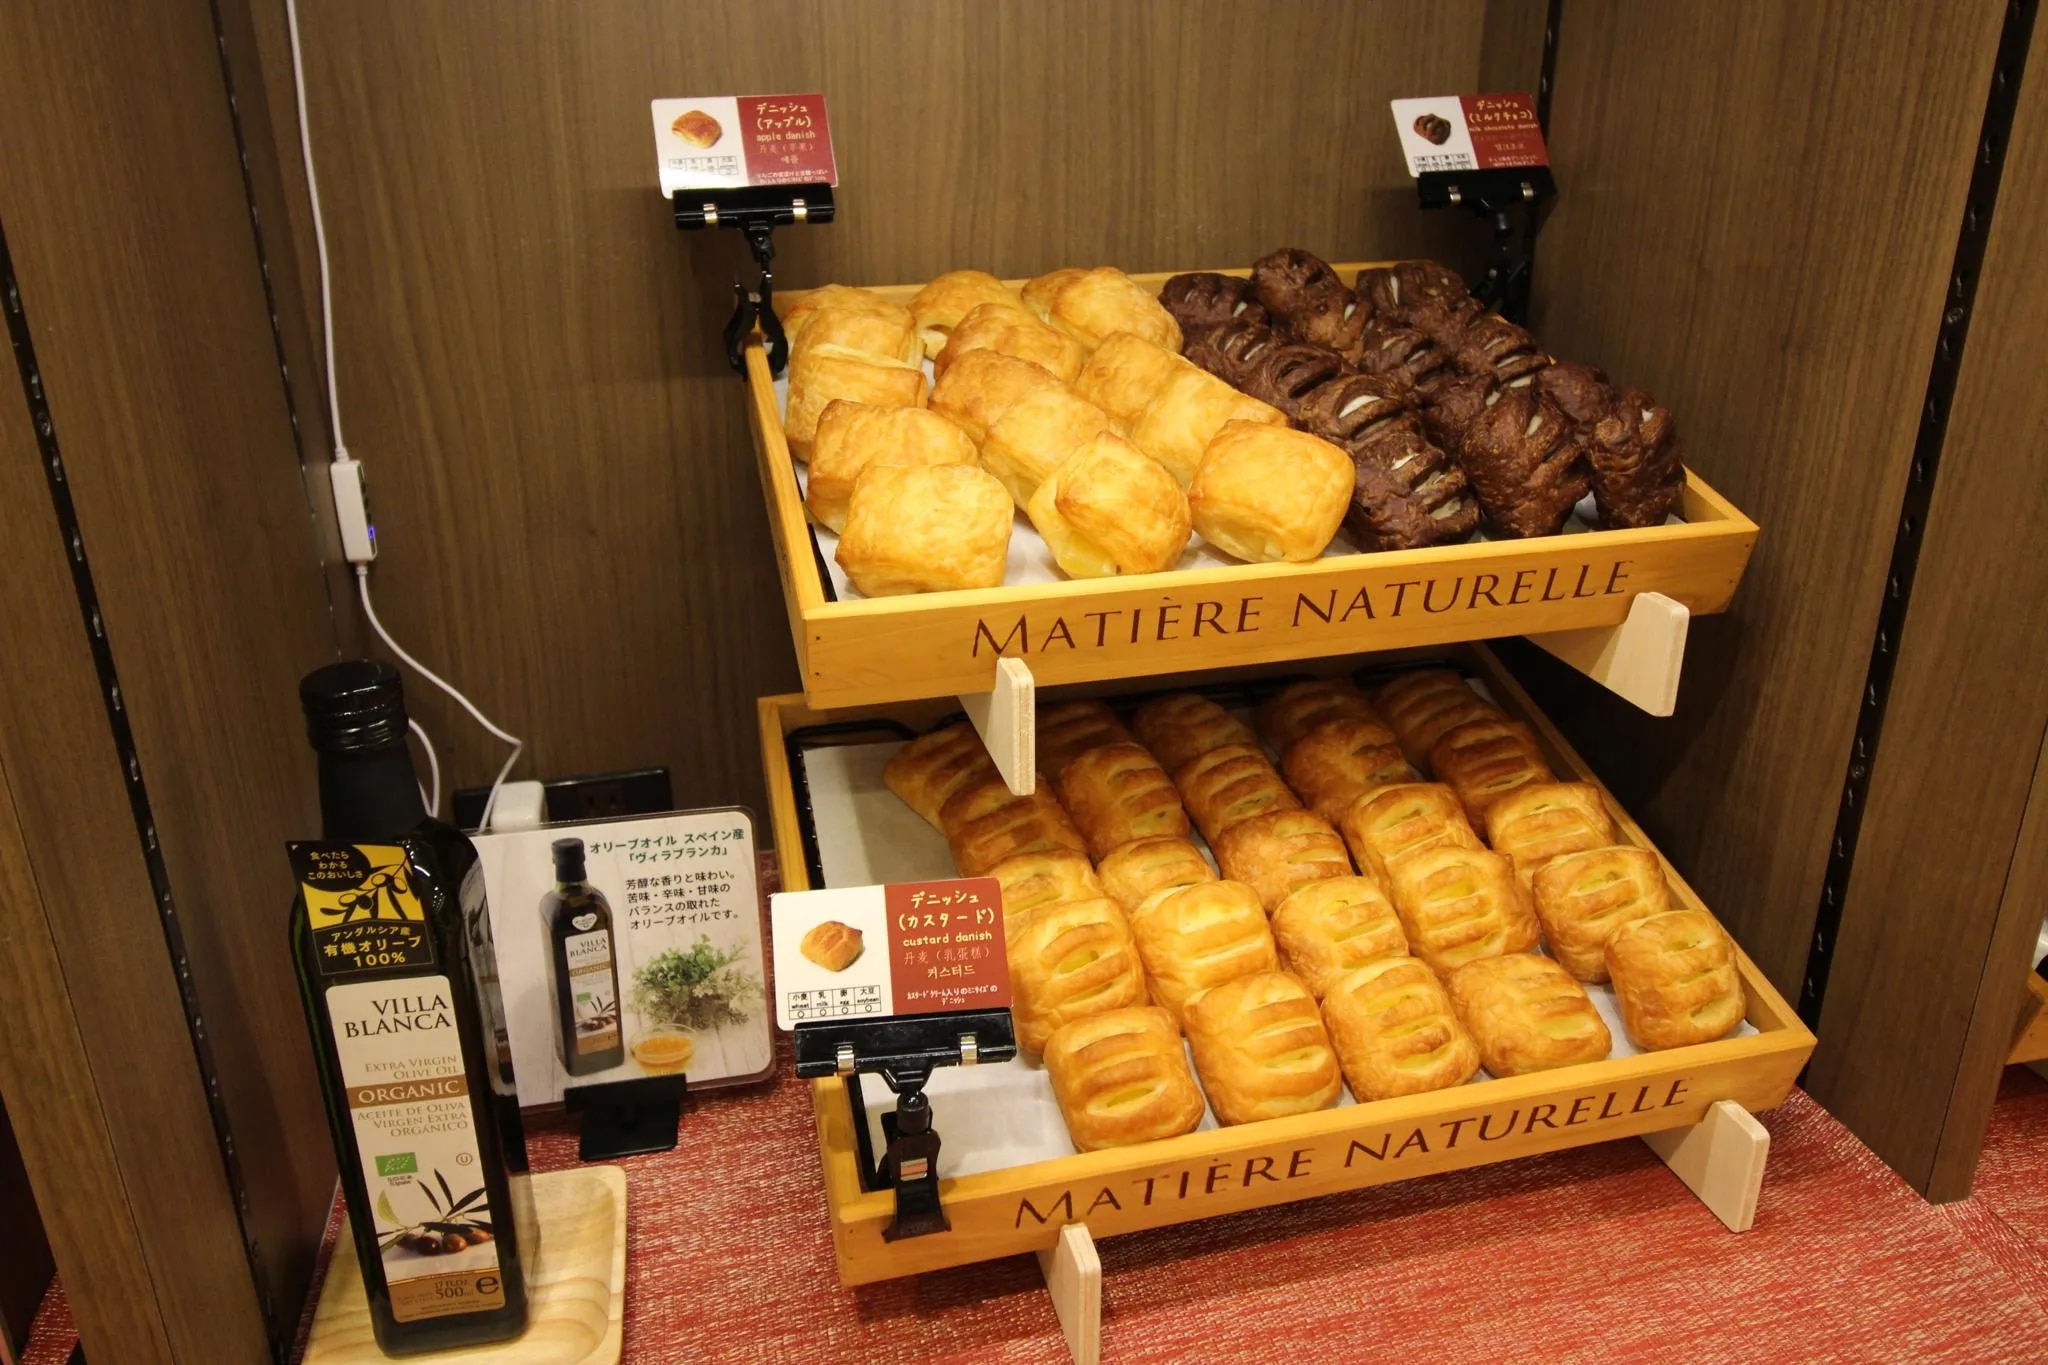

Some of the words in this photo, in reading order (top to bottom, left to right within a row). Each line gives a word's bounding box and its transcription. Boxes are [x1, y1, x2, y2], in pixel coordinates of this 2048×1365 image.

[756, 102, 808, 115] デニッシュ
[1476, 99, 1519, 110] デニッシュ
[756, 132, 781, 142] apple
[785, 130, 816, 140] danish
[972, 597, 1263, 658] MATIÈRE
[1291, 560, 1634, 627] NATURELLE
[590, 834, 677, 854] オリーブオイル
[684, 828, 744, 845] スペイン産
[309, 851, 350, 861] 食べたら
[629, 845, 728, 863] 「ヴィラブランカ」
[318, 862, 348, 870] わかる
[307, 871, 363, 880] このおいしさ
[625, 870, 735, 890] 芳醇な香りと味わい。
[627, 884, 730, 904] 苦味・辛味・甘味の
[911, 890, 979, 909] デニッシュ
[629, 898, 720, 917] バランスの取れた
[630, 910, 739, 930] オリーブオイルです。
[331, 926, 411, 942] アンダルシア産
[903, 932, 950, 947] custard
[955, 930, 992, 943] danish
[354, 951, 406, 967] 100%
[927, 965, 976, 978] 커스터드
[371, 994, 448, 1015] VILLA
[344, 1013, 452, 1038] BLANCA
[365, 1061, 405, 1073] EXTRA
[408, 1055, 457, 1068] VIRGIN
[394, 1069, 432, 1080] OLIVE
[435, 1065, 458, 1076] OIL
[358, 1080, 460, 1103] ORGANIC
[357, 1108, 401, 1121] ACEITE
[406, 1106, 423, 1115] DE
[427, 1102, 465, 1113] OLIVA
[373, 1117, 423, 1129] VIRGEN
[427, 1111, 467, 1123] EXTRA
[1015, 1147, 1316, 1228] MATIÈRE
[1344, 1078, 1694, 1168] NATURELLE
[435, 1287, 464, 1299] 500
